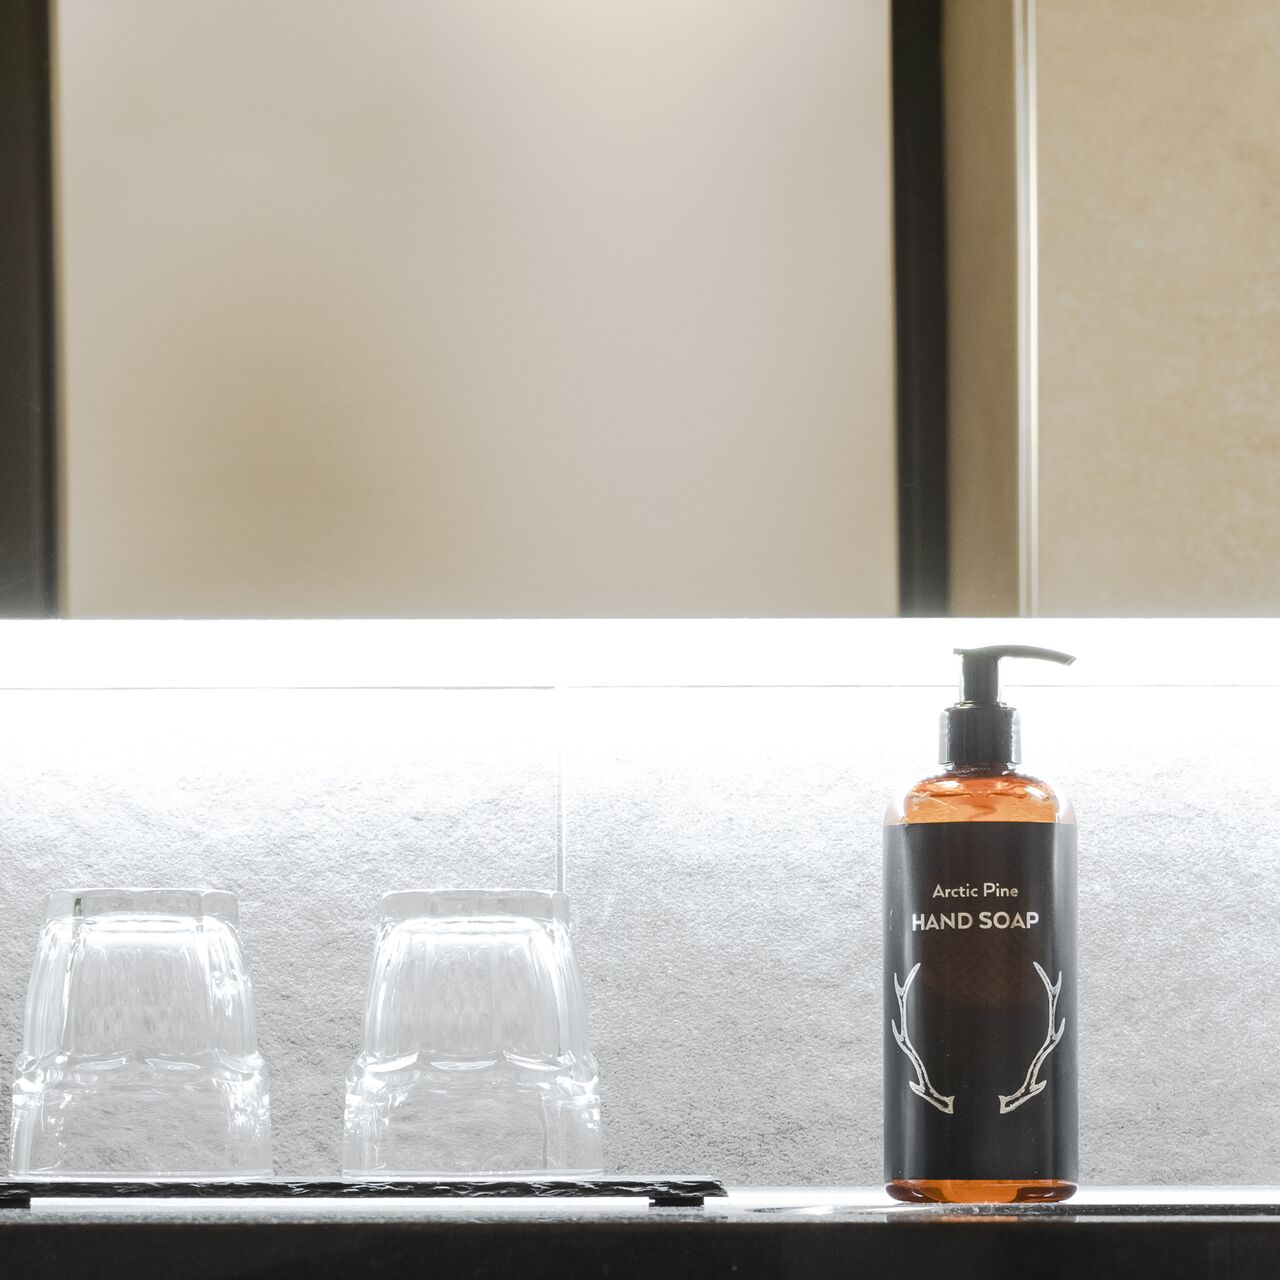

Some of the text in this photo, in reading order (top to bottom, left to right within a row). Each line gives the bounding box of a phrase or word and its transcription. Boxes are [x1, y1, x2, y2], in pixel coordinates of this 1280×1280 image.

[932, 882, 1019, 898] Arctic Pine
[912, 911, 1040, 931] HAND SOAP
